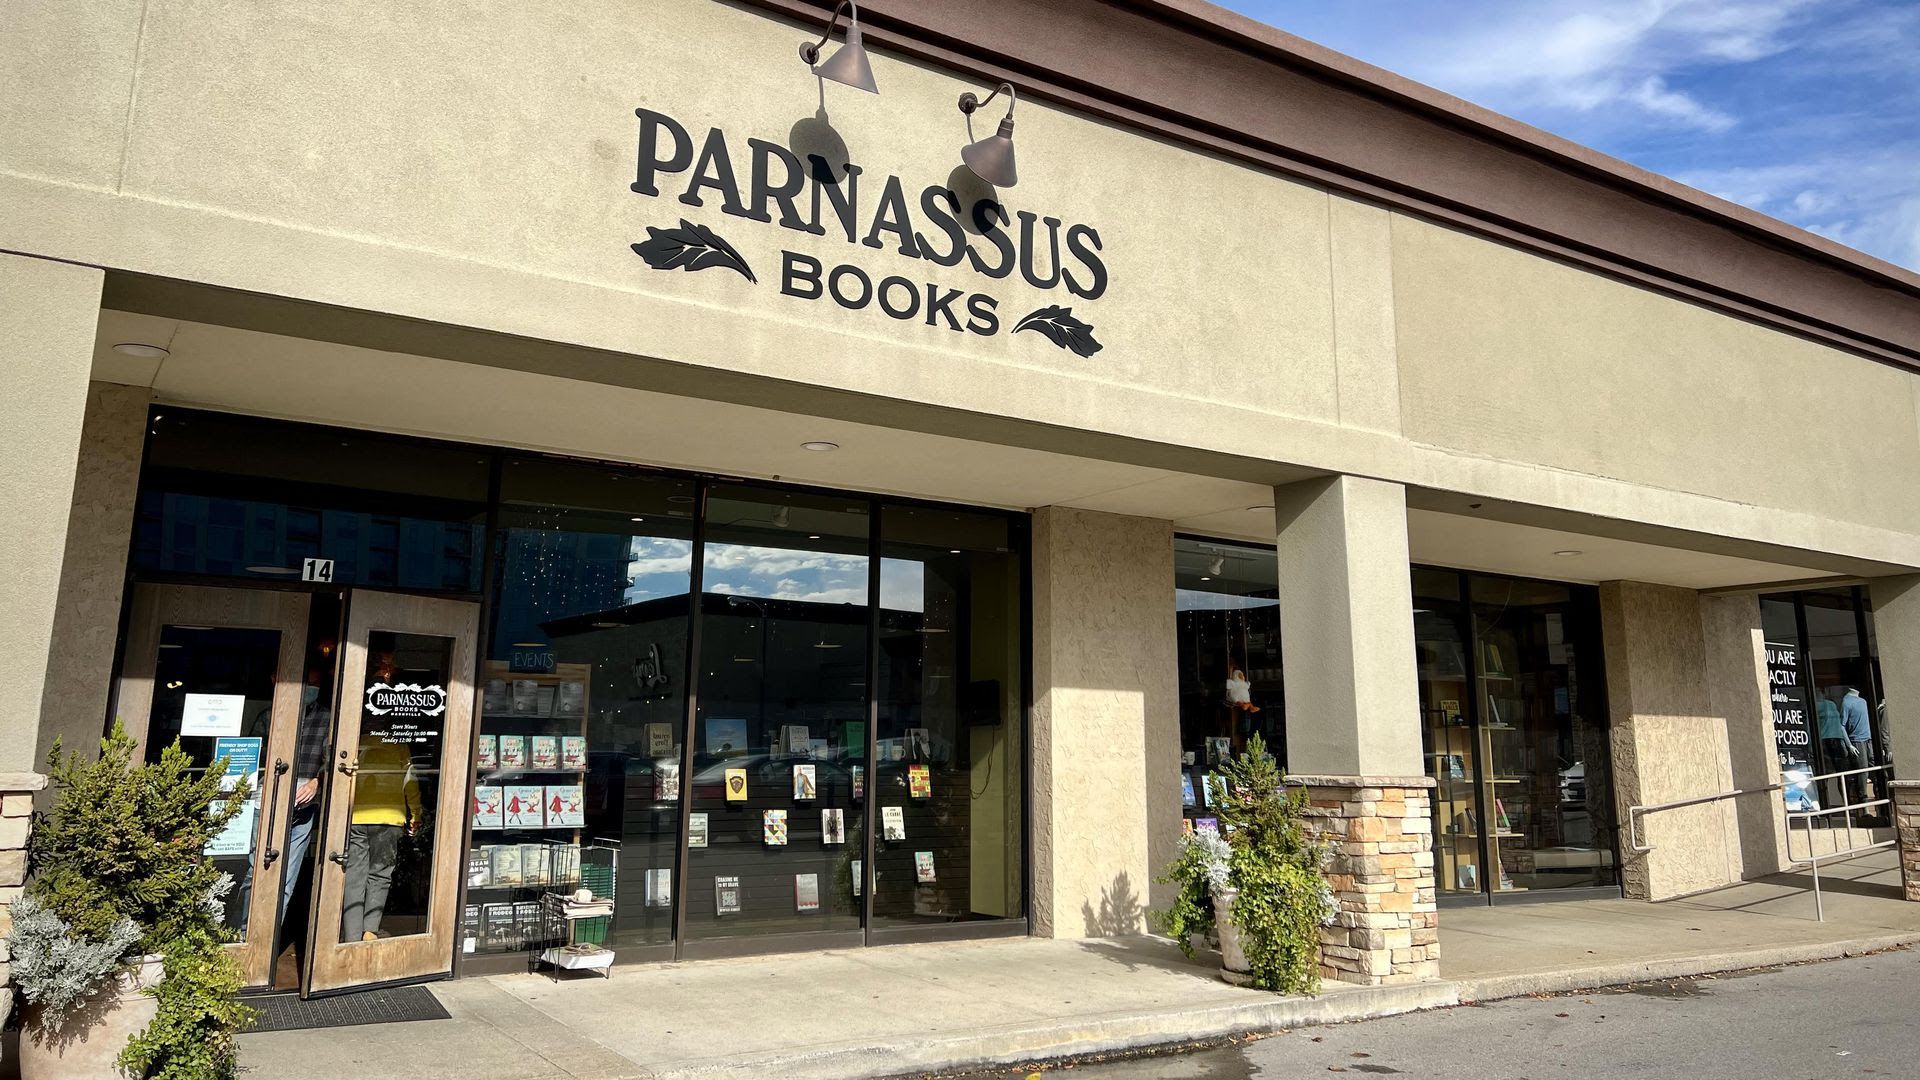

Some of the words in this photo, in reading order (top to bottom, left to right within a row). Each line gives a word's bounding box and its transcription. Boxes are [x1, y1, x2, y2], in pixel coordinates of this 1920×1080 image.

[631, 108, 1108, 300] PARNASSUS
[780, 250, 1000, 336] BOOKS
[307, 560, 331, 582] 14
[514, 652, 554, 669] EVENTS
[1777, 651, 1796, 665] ARE
[1769, 669, 1796, 685] ACTLY
[376, 693, 436, 707] PARNASSUS
[1771, 709, 1783, 724] OU
[1785, 710, 1803, 724] ARE
[1774, 730, 1808, 745] PPOSED
